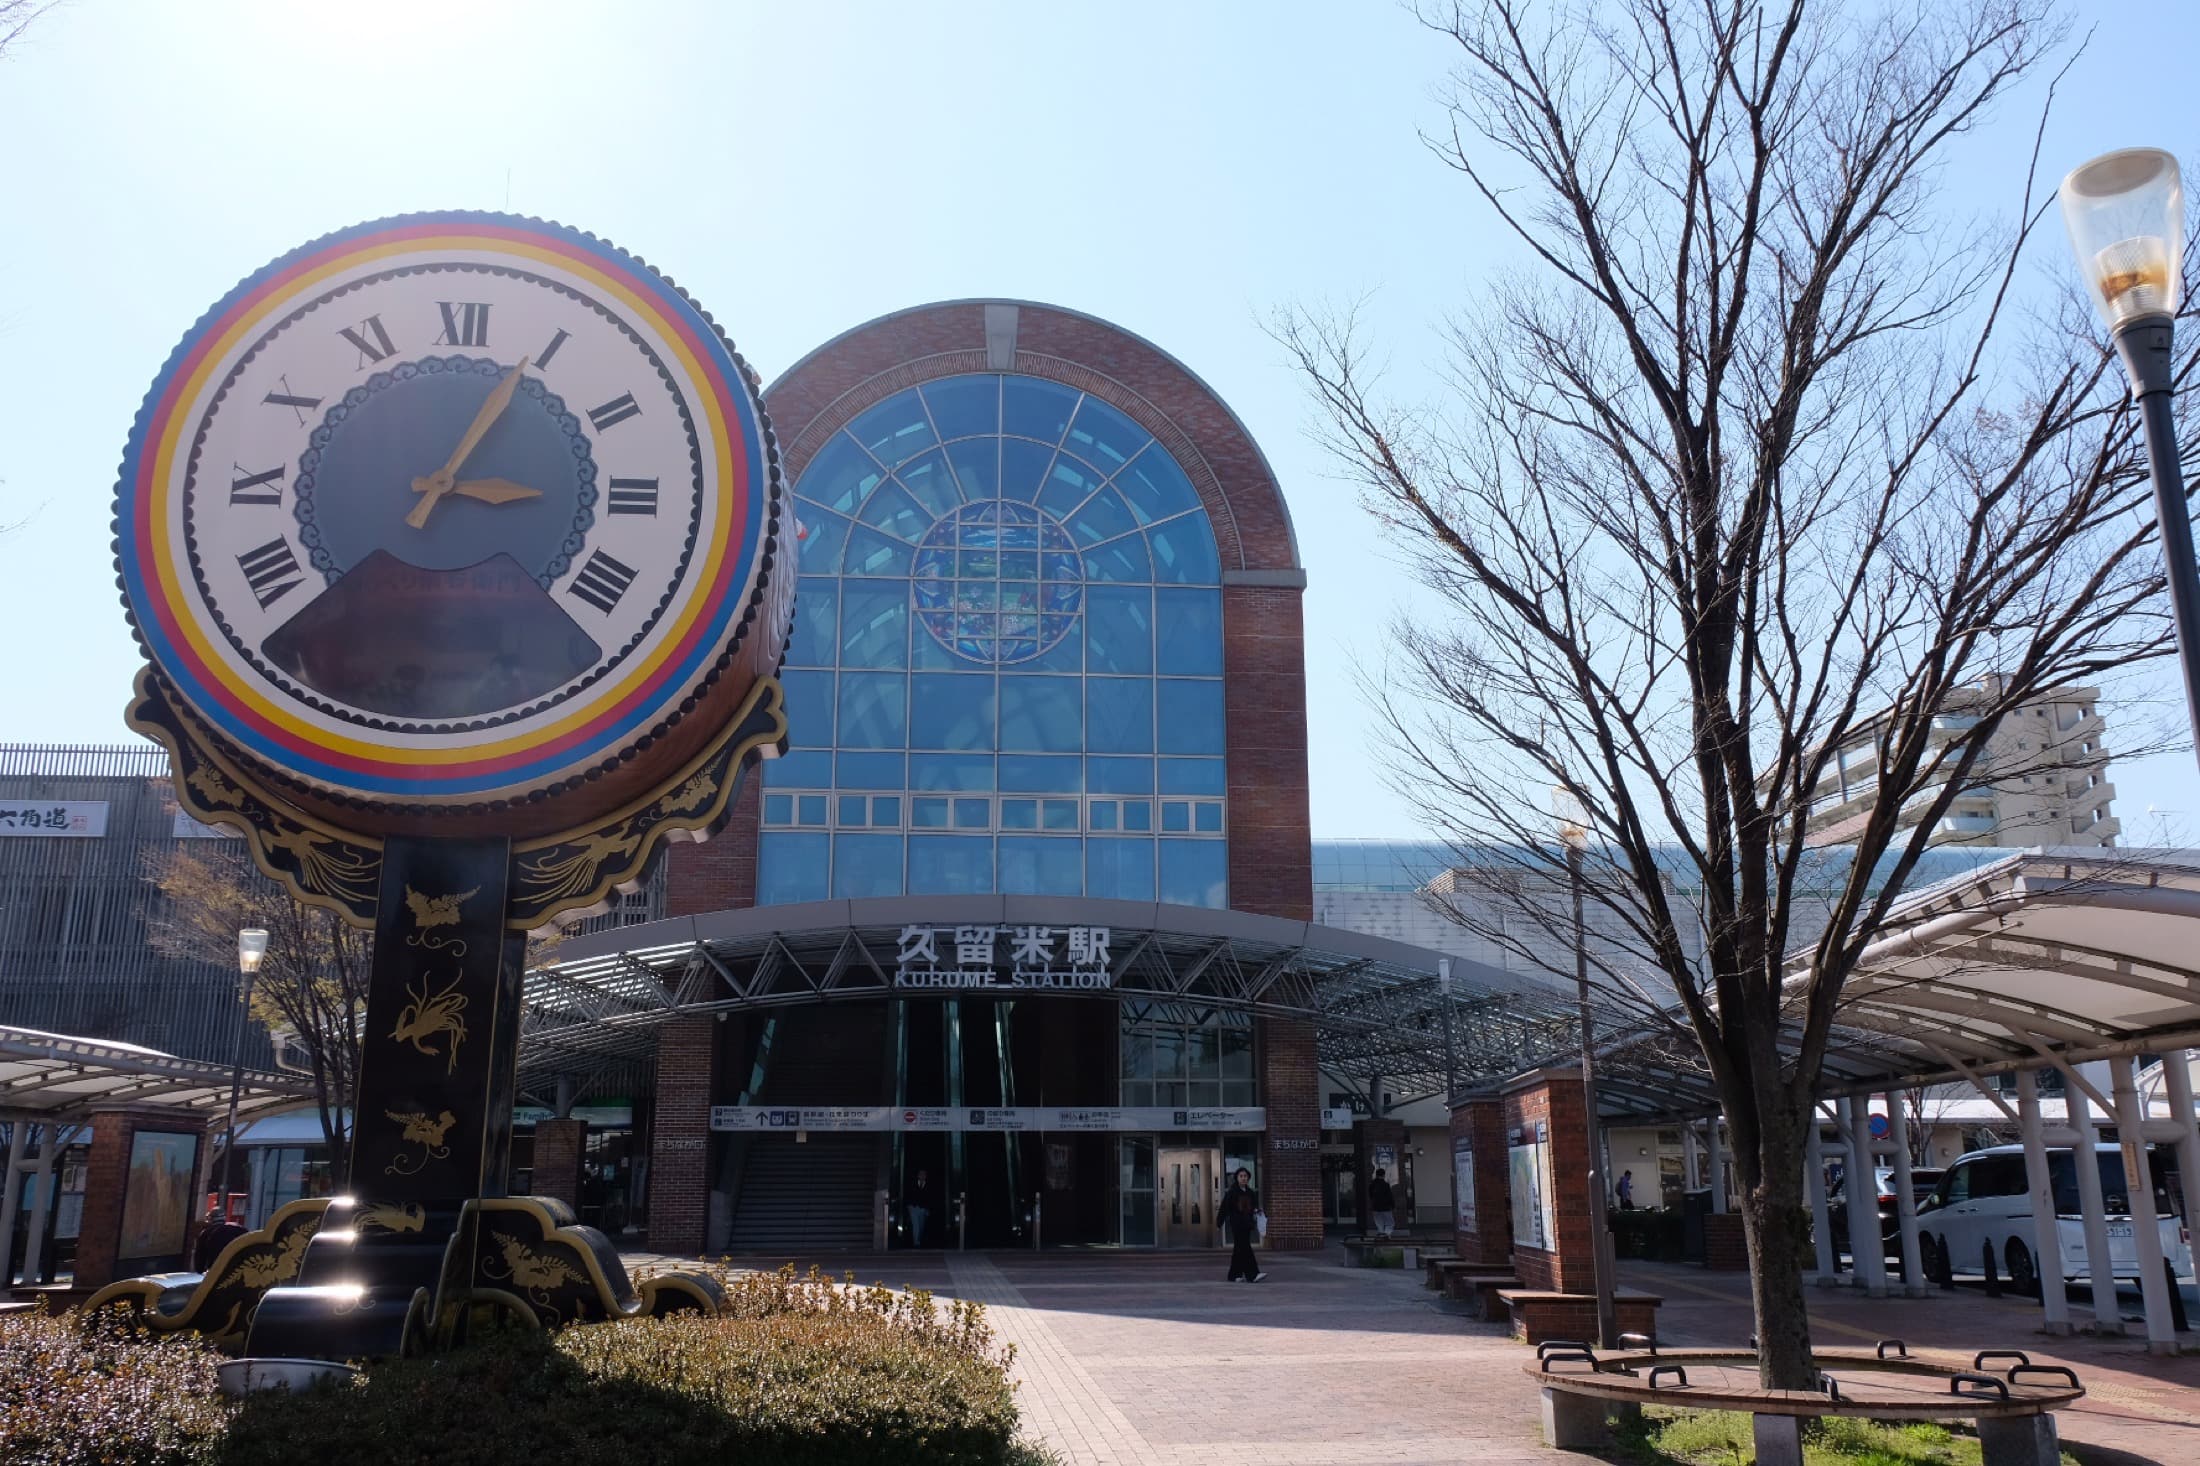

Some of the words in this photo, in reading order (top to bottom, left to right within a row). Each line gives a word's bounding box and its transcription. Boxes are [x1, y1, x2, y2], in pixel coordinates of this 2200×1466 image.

[336, 314, 400, 371] XI
[432, 301, 494, 348] XII
[531, 327, 571, 372] I
[261, 374, 325, 427] X
[585, 390, 643, 434] II
[229, 462, 286, 508] IX
[607, 474, 659, 518] III
[235, 533, 307, 612] VIII
[896, 924, 1111, 965] 久留米駅
[894, 971, 997, 987] KURUME
[1011, 972, 1112, 989] STATION
